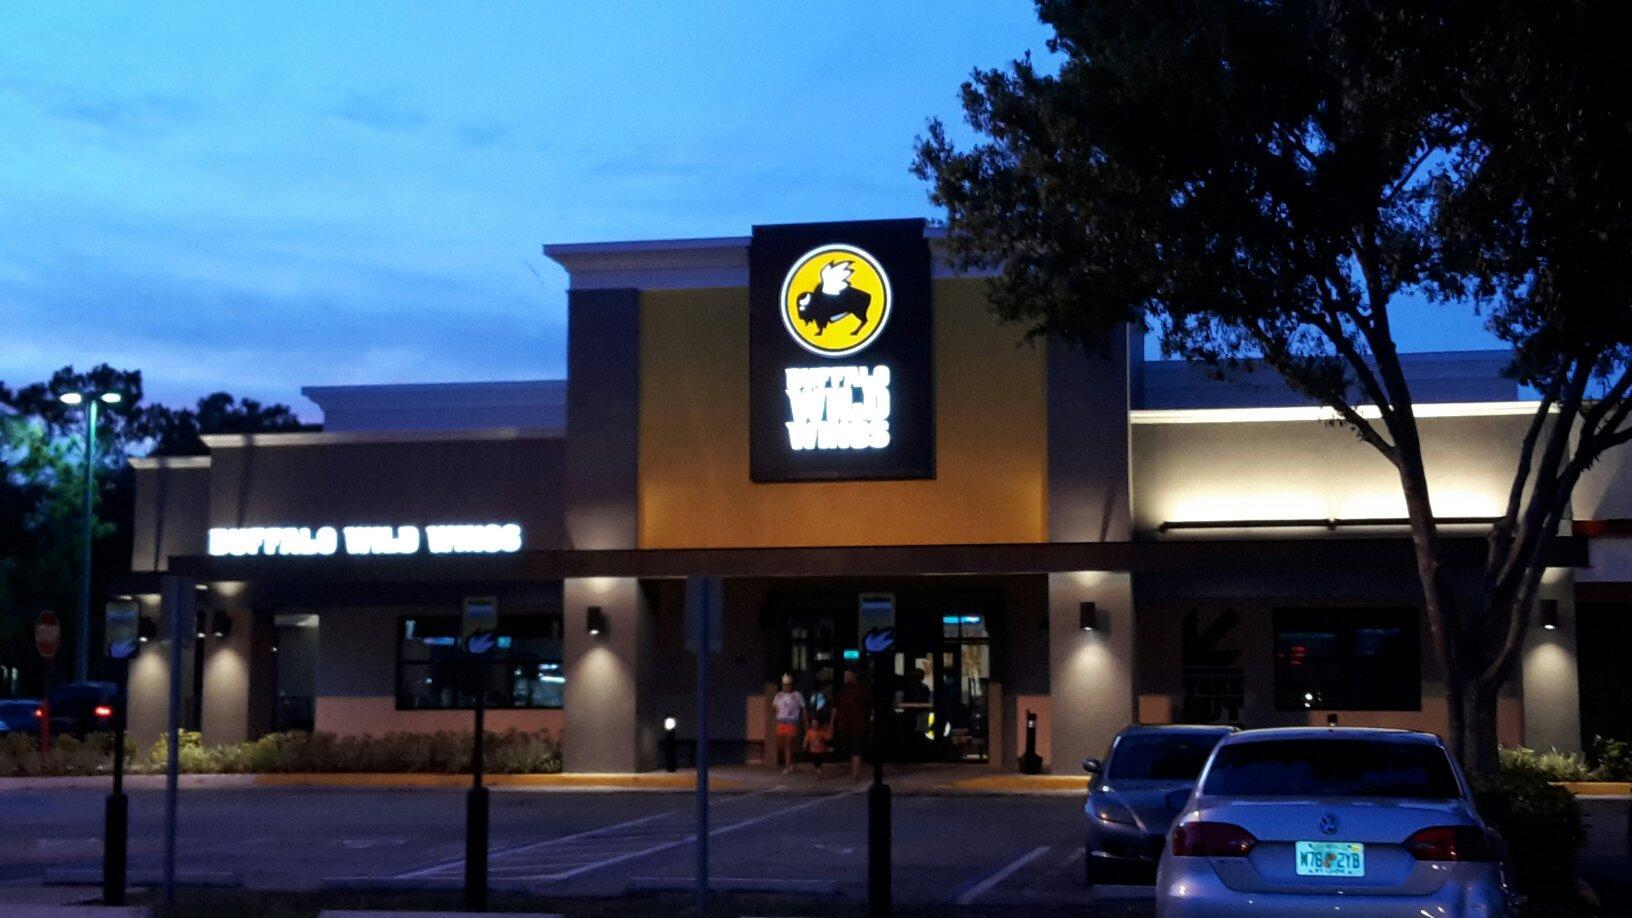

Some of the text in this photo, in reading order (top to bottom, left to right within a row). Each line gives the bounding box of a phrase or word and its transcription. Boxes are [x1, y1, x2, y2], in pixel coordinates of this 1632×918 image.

[784, 365, 890, 389] BUFFALO
[784, 388, 890, 421] WILD
[784, 420, 890, 450] WINGS
[208, 523, 522, 556] BUFFALO WILD WINGS
